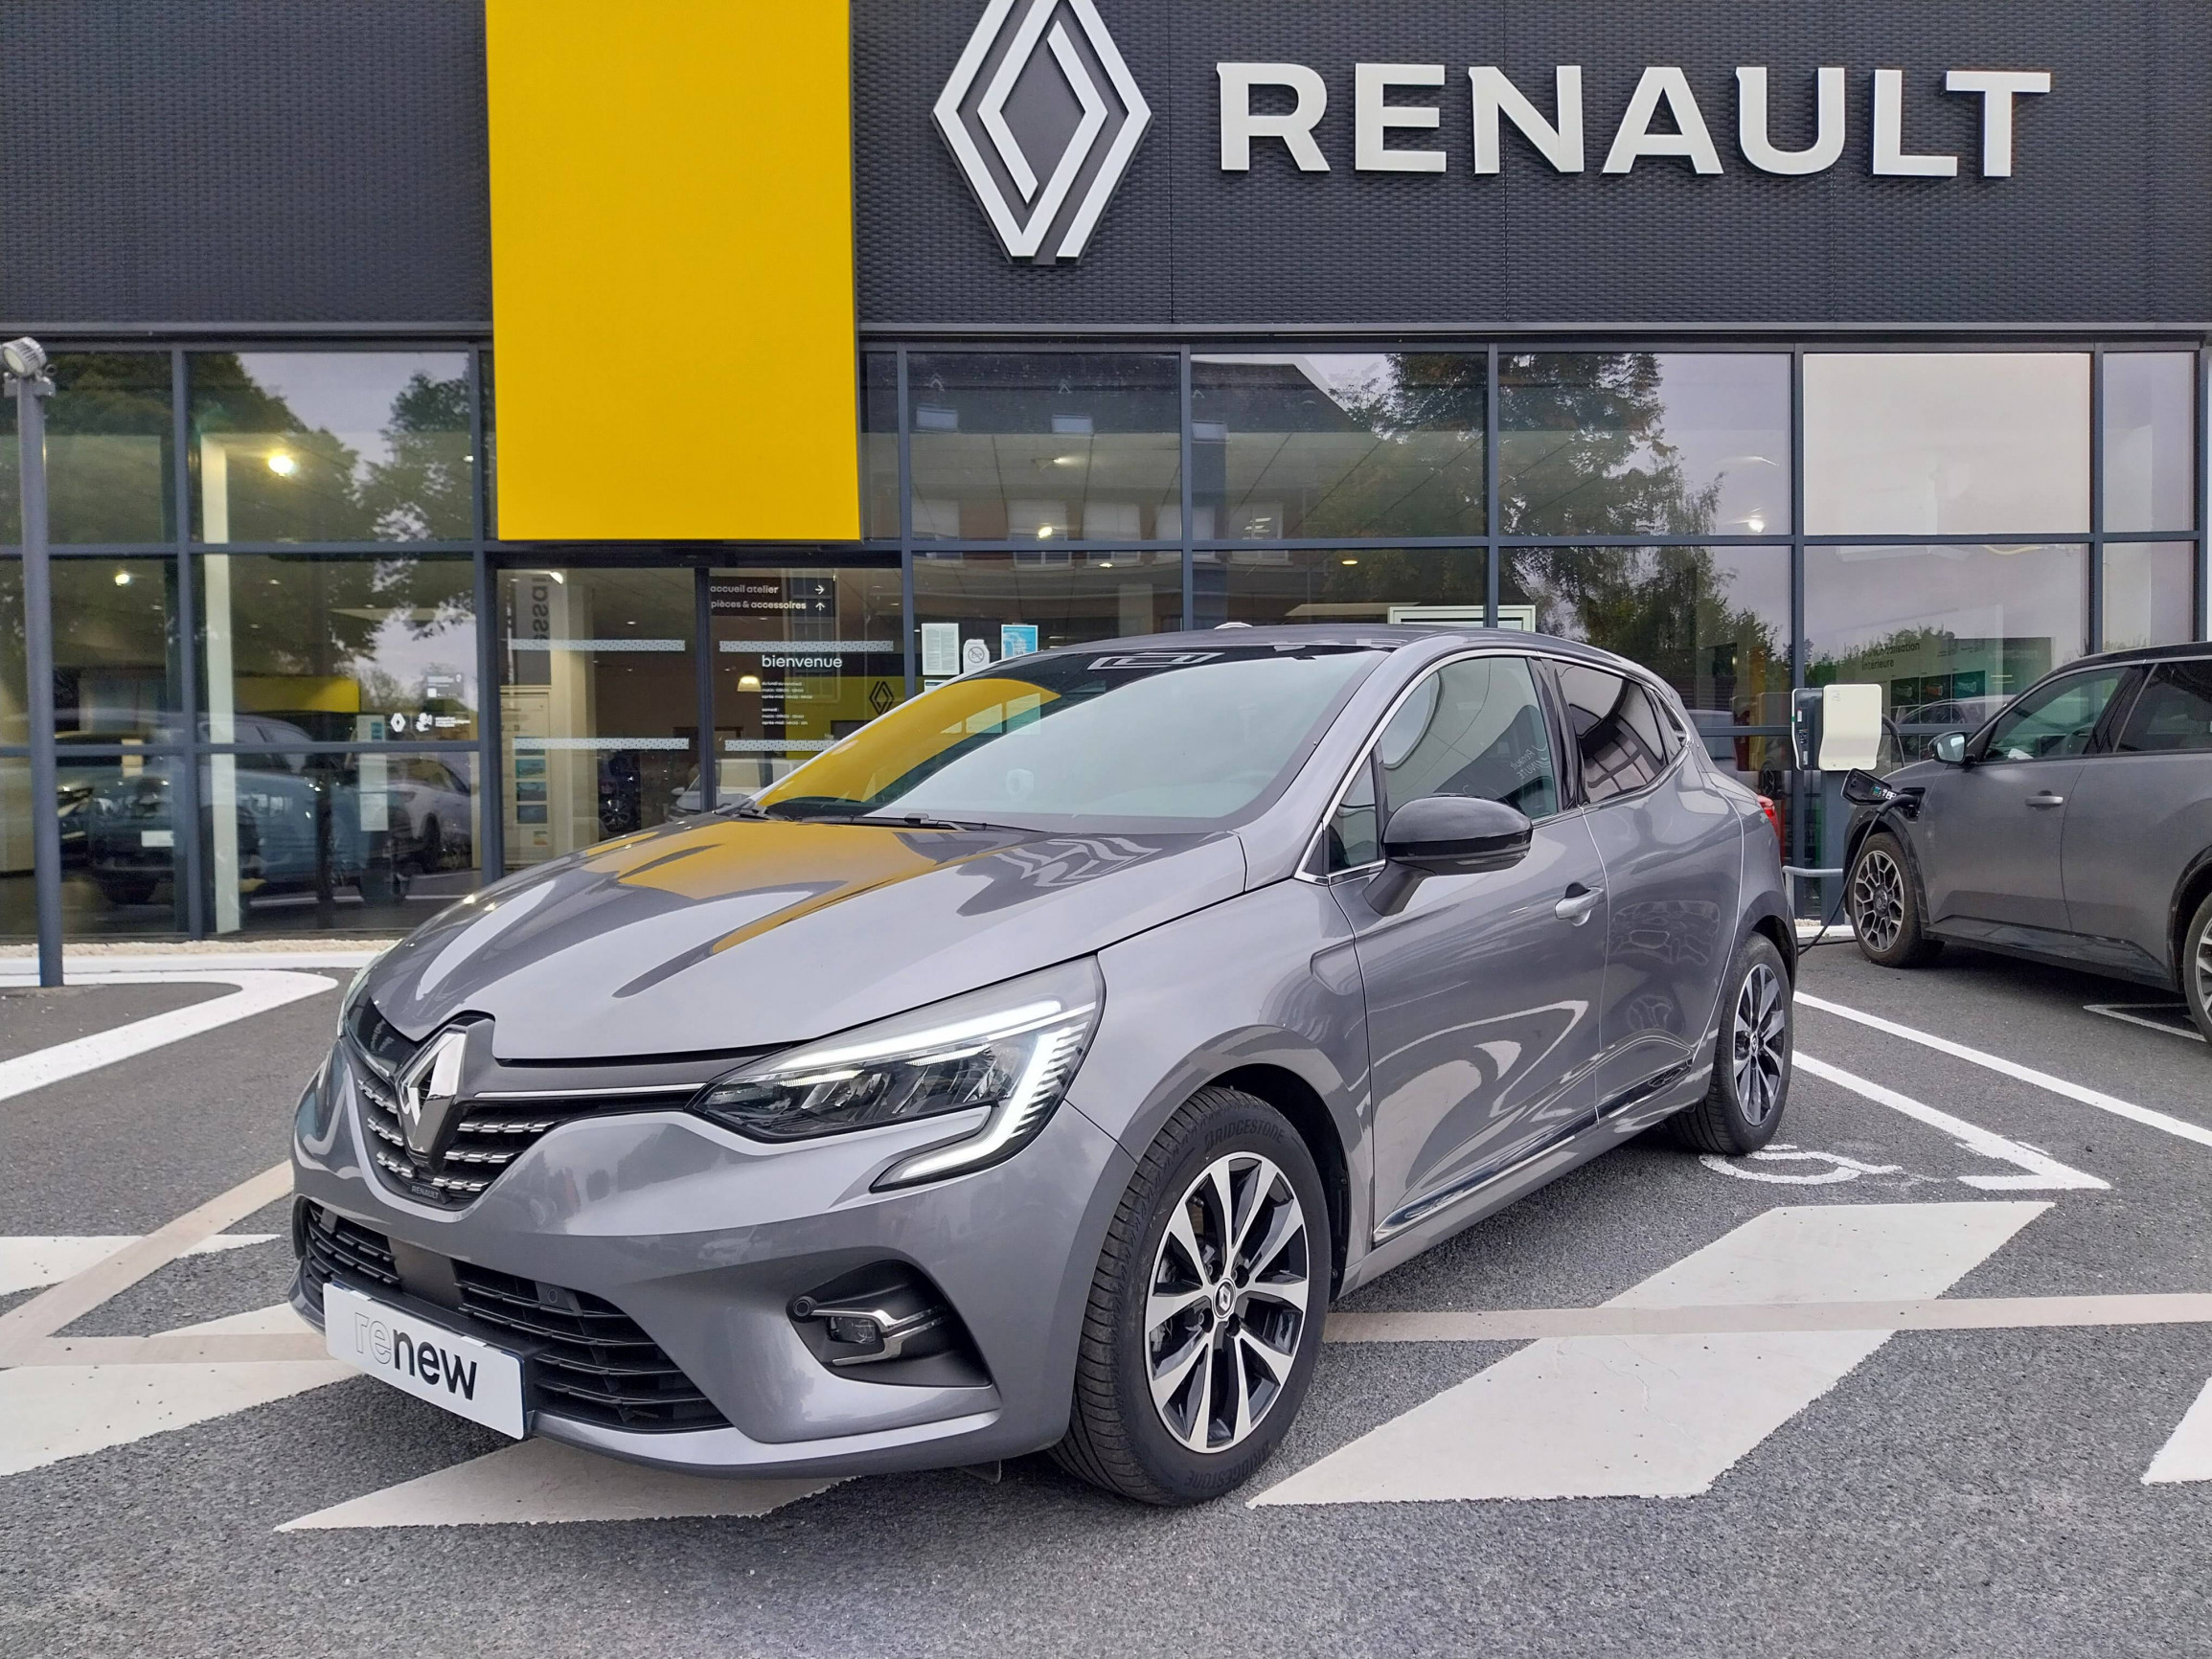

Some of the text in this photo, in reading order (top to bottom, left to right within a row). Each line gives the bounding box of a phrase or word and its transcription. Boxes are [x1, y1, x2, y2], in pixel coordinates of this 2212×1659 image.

[1216, 62, 2052, 178] RENAULT
[747, 585, 779, 594] atelier
[711, 600, 741, 609] pièces
[750, 601, 807, 609] accessoires
[762, 654, 843, 668] bienvenue
[1204, 1117, 1286, 1153] BRIDGESTONE
[412, 1185, 440, 1199] RENAULT
[354, 1311, 477, 1401] renew
